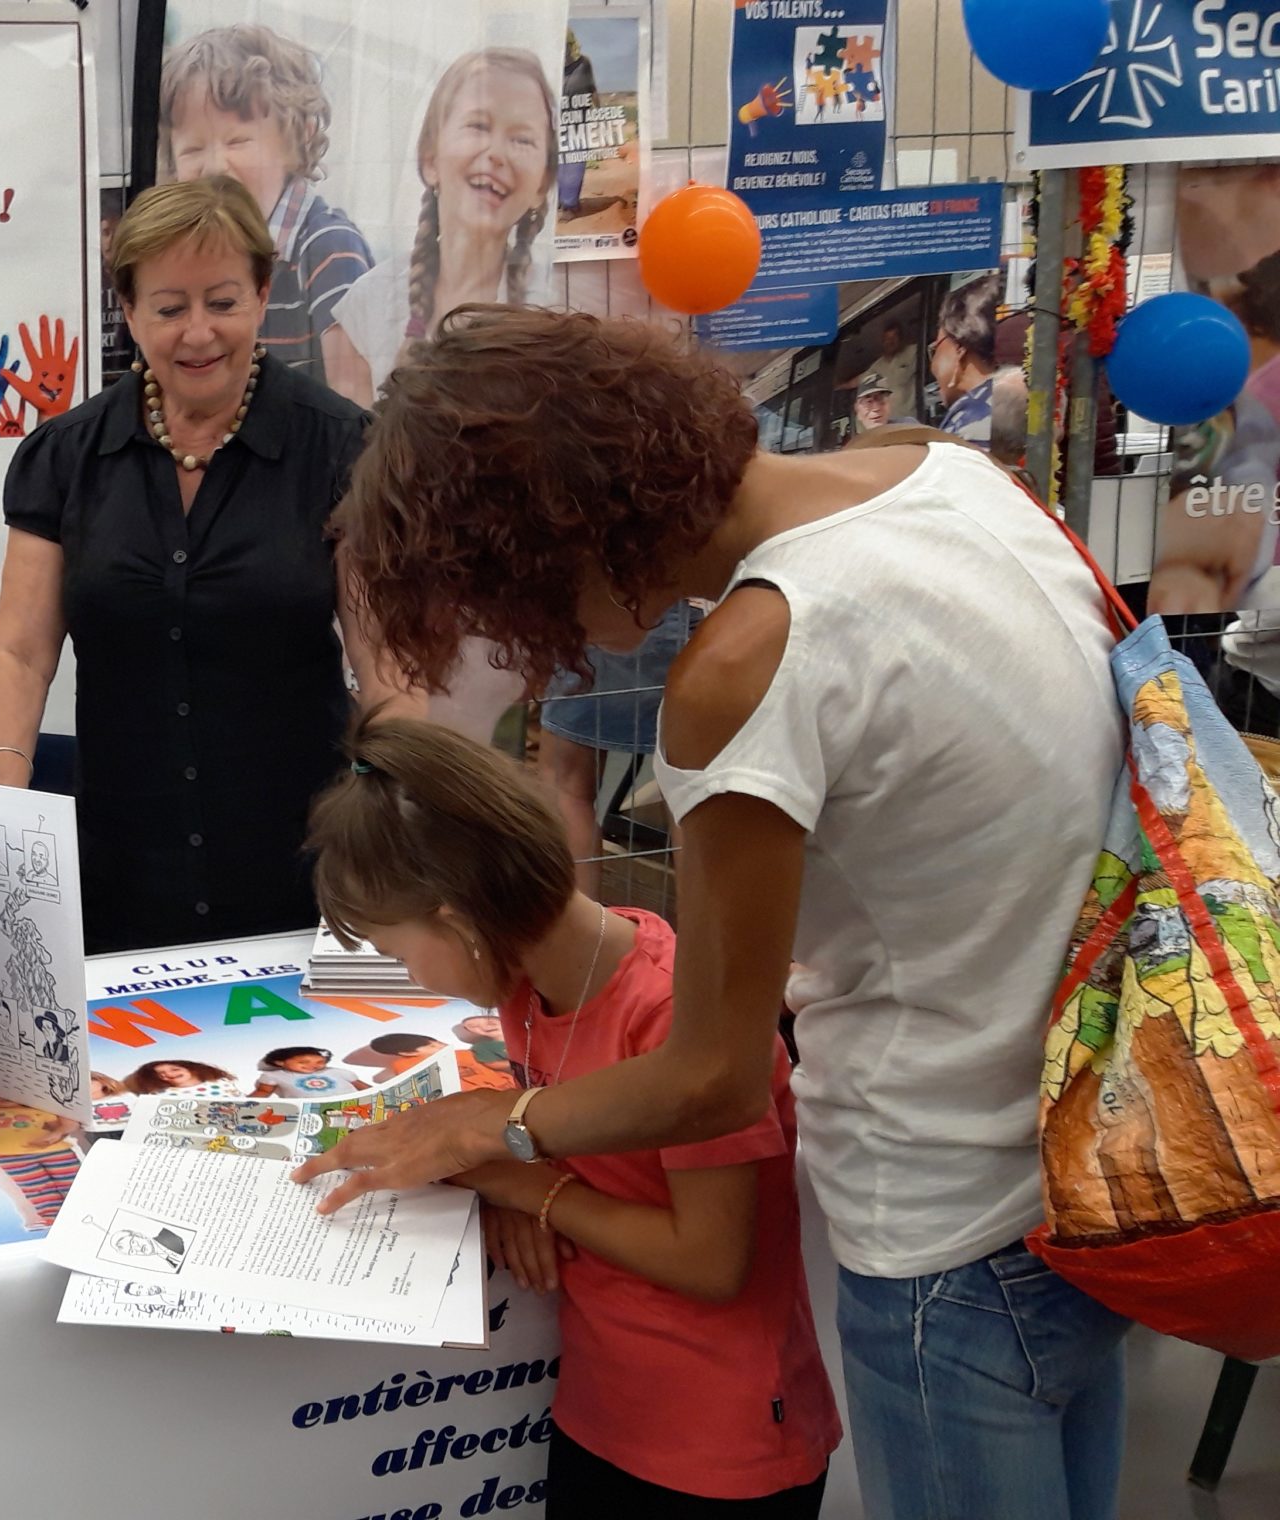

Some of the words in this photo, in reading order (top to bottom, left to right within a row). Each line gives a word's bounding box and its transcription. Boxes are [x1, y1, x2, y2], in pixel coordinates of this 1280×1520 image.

[1199, 68, 1280, 115] Cari
[560, 110, 583, 125] CUN
[559, 119, 626, 153] EMENT
[780, 208, 842, 228] CATHOLIQUE
[849, 203, 891, 222] CARITAS
[892, 201, 929, 219] FRANCE
[1185, 473, 1265, 518] être
[103, 973, 219, 996] MENDE
[237, 963, 302, 978] LES
[291, 1354, 561, 1430] entièrem
